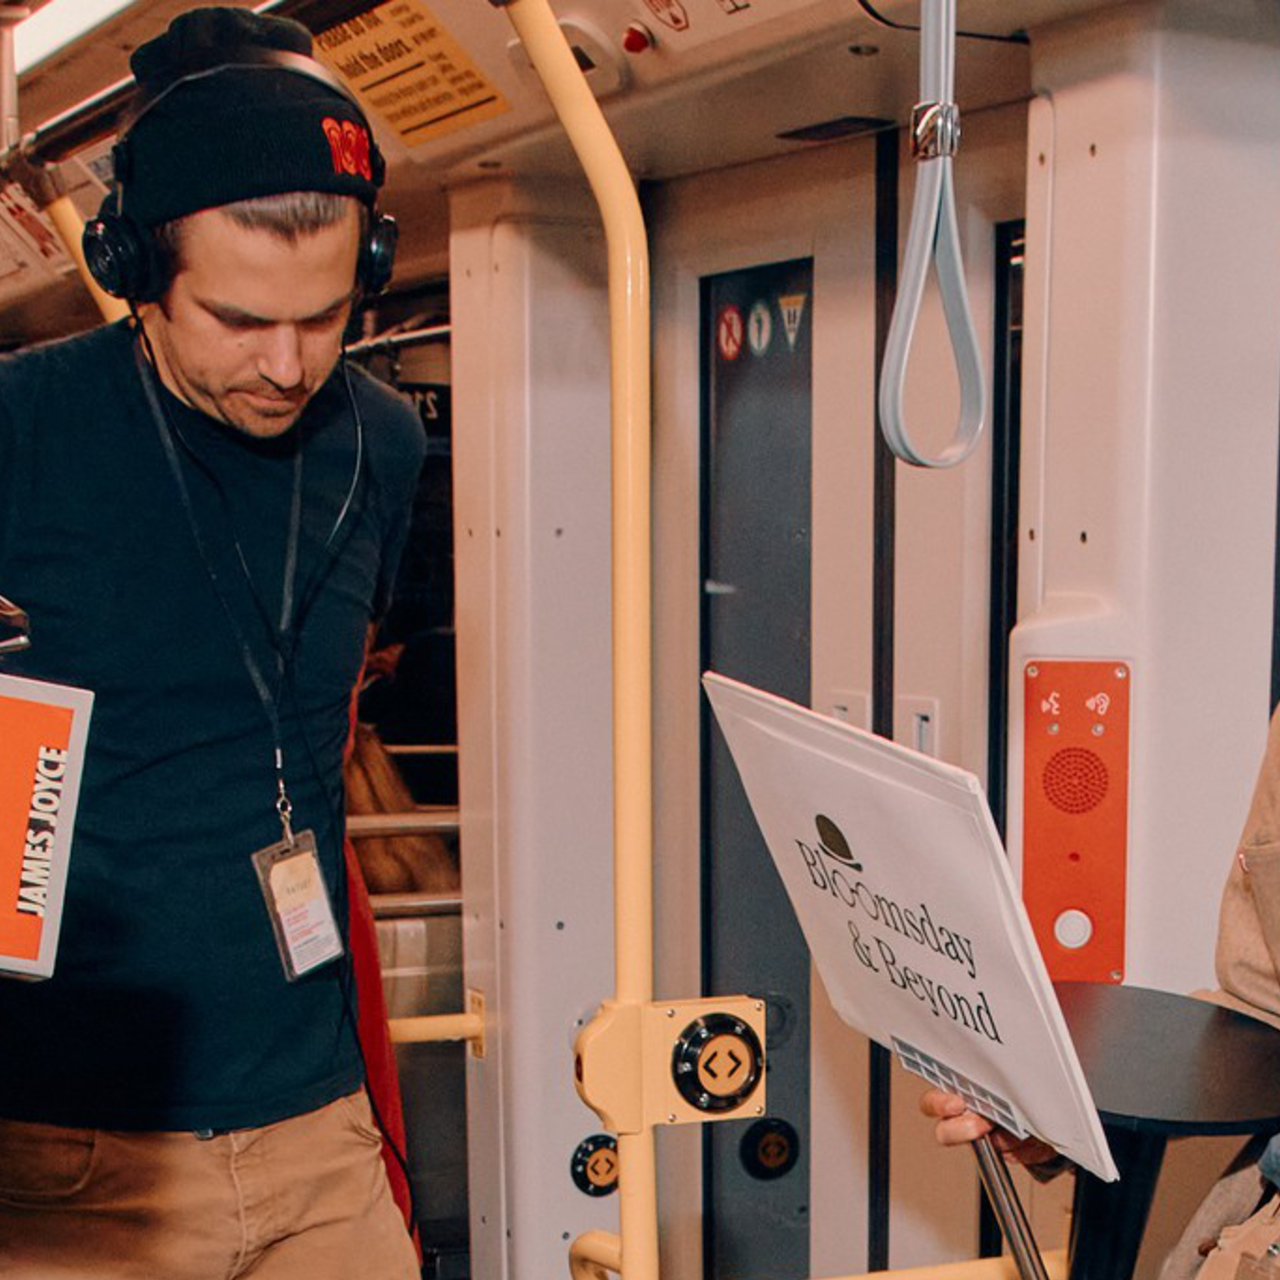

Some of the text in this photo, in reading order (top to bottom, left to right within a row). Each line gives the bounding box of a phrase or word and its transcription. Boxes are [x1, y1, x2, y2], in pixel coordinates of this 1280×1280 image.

[334, 51, 369, 80] hold
[358, 47, 385, 71] the
[16, 745, 69, 917] JAMES JOYCE
[795, 838, 977, 979] Bloomsday
[847, 919, 1004, 1045] & Beyond
